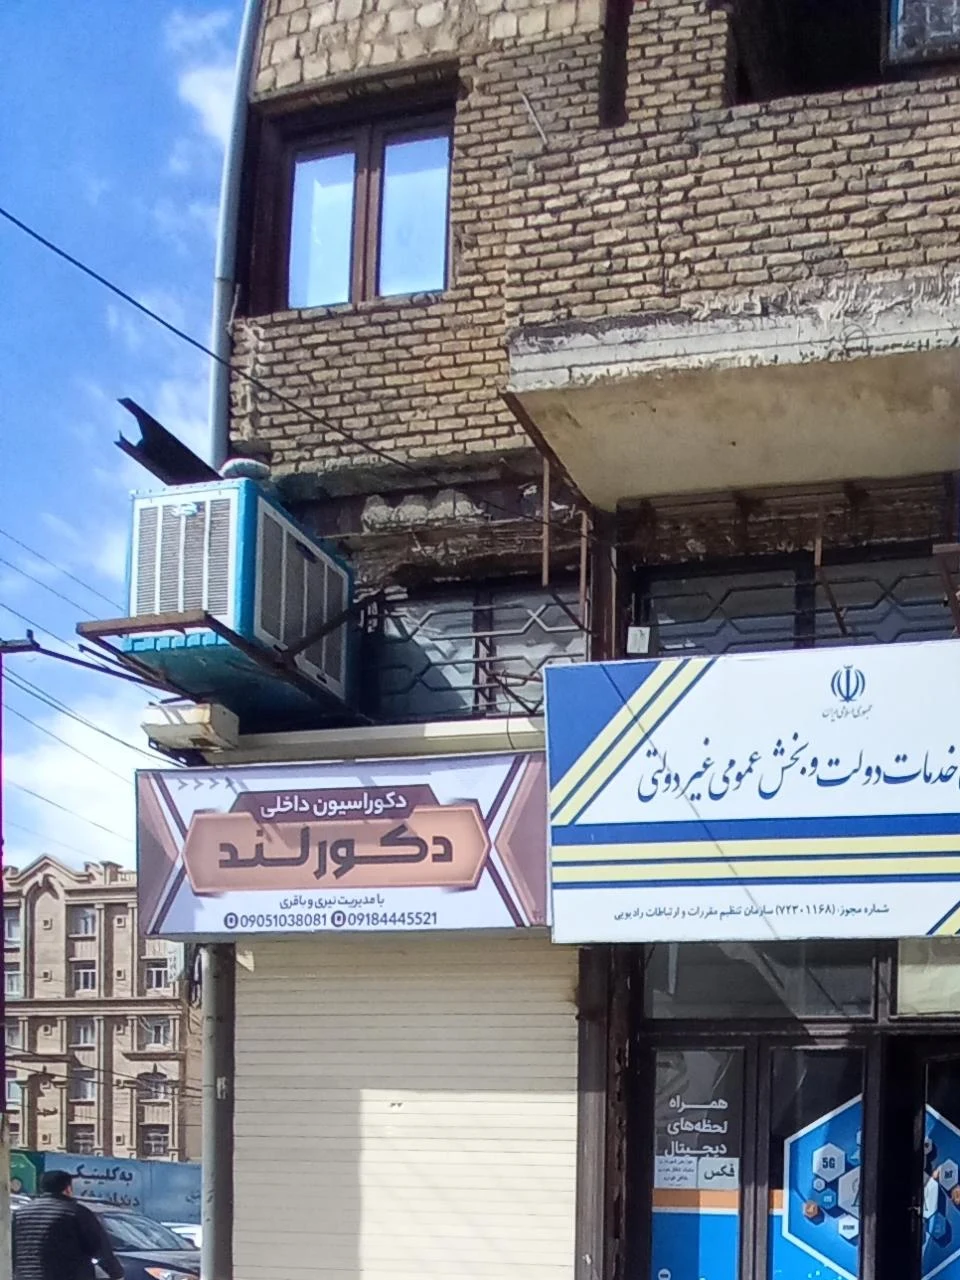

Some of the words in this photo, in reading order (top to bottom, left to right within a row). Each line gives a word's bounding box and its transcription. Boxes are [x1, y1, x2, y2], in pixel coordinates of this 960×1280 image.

[758, 732, 809, 800] بخش
[816, 750, 882, 787] دولت
[883, 745, 958, 784] خدمات
[708, 751, 762, 801] عمومی
[260, 795, 310, 818] داخلی
[313, 791, 407, 816] دکوراسیون
[218, 824, 453, 880] دکورلند
[337, 895, 375, 909] مدیریت
[377, 893, 385, 908] با
[645, 906, 680, 918] ارتباطات
[687, 906, 718, 919] مقررات
[720, 905, 742, 920] تنظیم
[744, 904, 773, 917] سازمان
[864, 903, 890, 917] شماره
[240, 914, 328, 928] 09051038081
[347, 911, 438, 926] 09184445521
[668, 1094, 729, 1113] همراه
[822, 1157, 836, 1169] 5G
